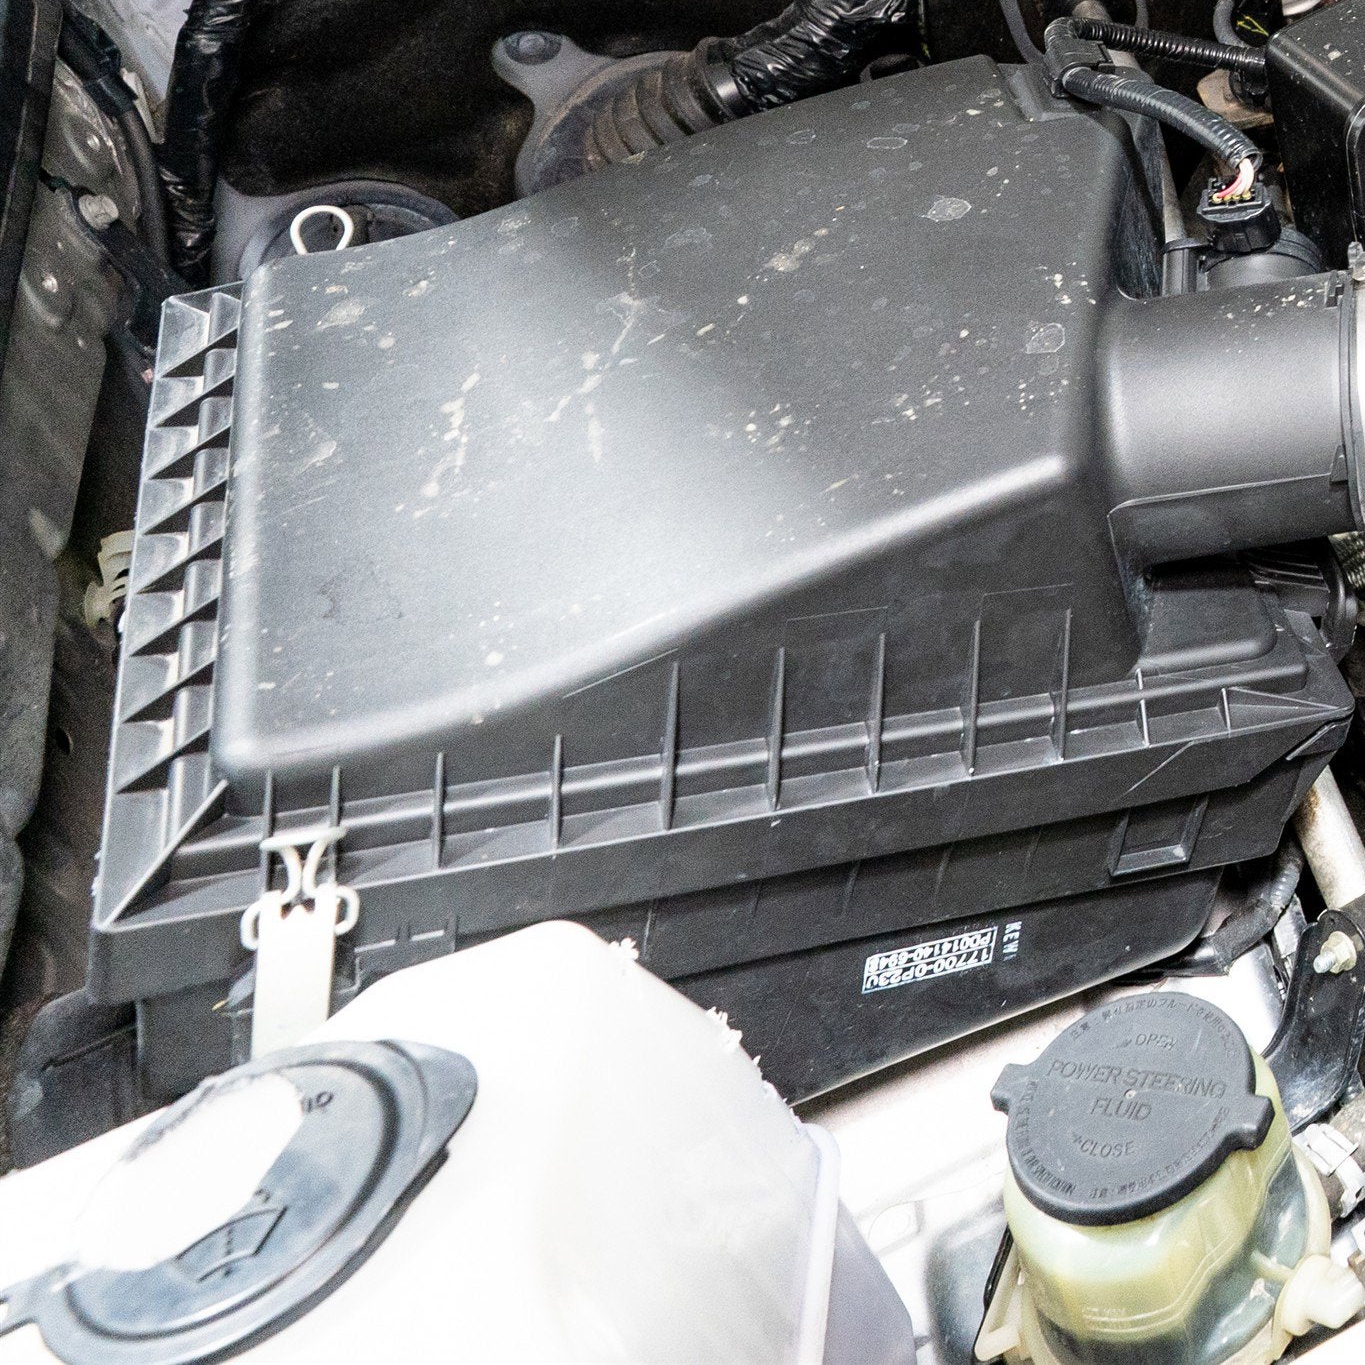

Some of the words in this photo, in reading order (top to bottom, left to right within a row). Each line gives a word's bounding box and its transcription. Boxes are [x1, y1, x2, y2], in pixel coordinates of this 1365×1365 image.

[1134, 1031, 1178, 1051] OPEN
[1047, 1058, 1124, 1086] POWER
[1123, 1068, 1227, 1100] STEERING
[1089, 1096, 1153, 1122] FLUID
[1078, 1140, 1137, 1161] CLOSE
